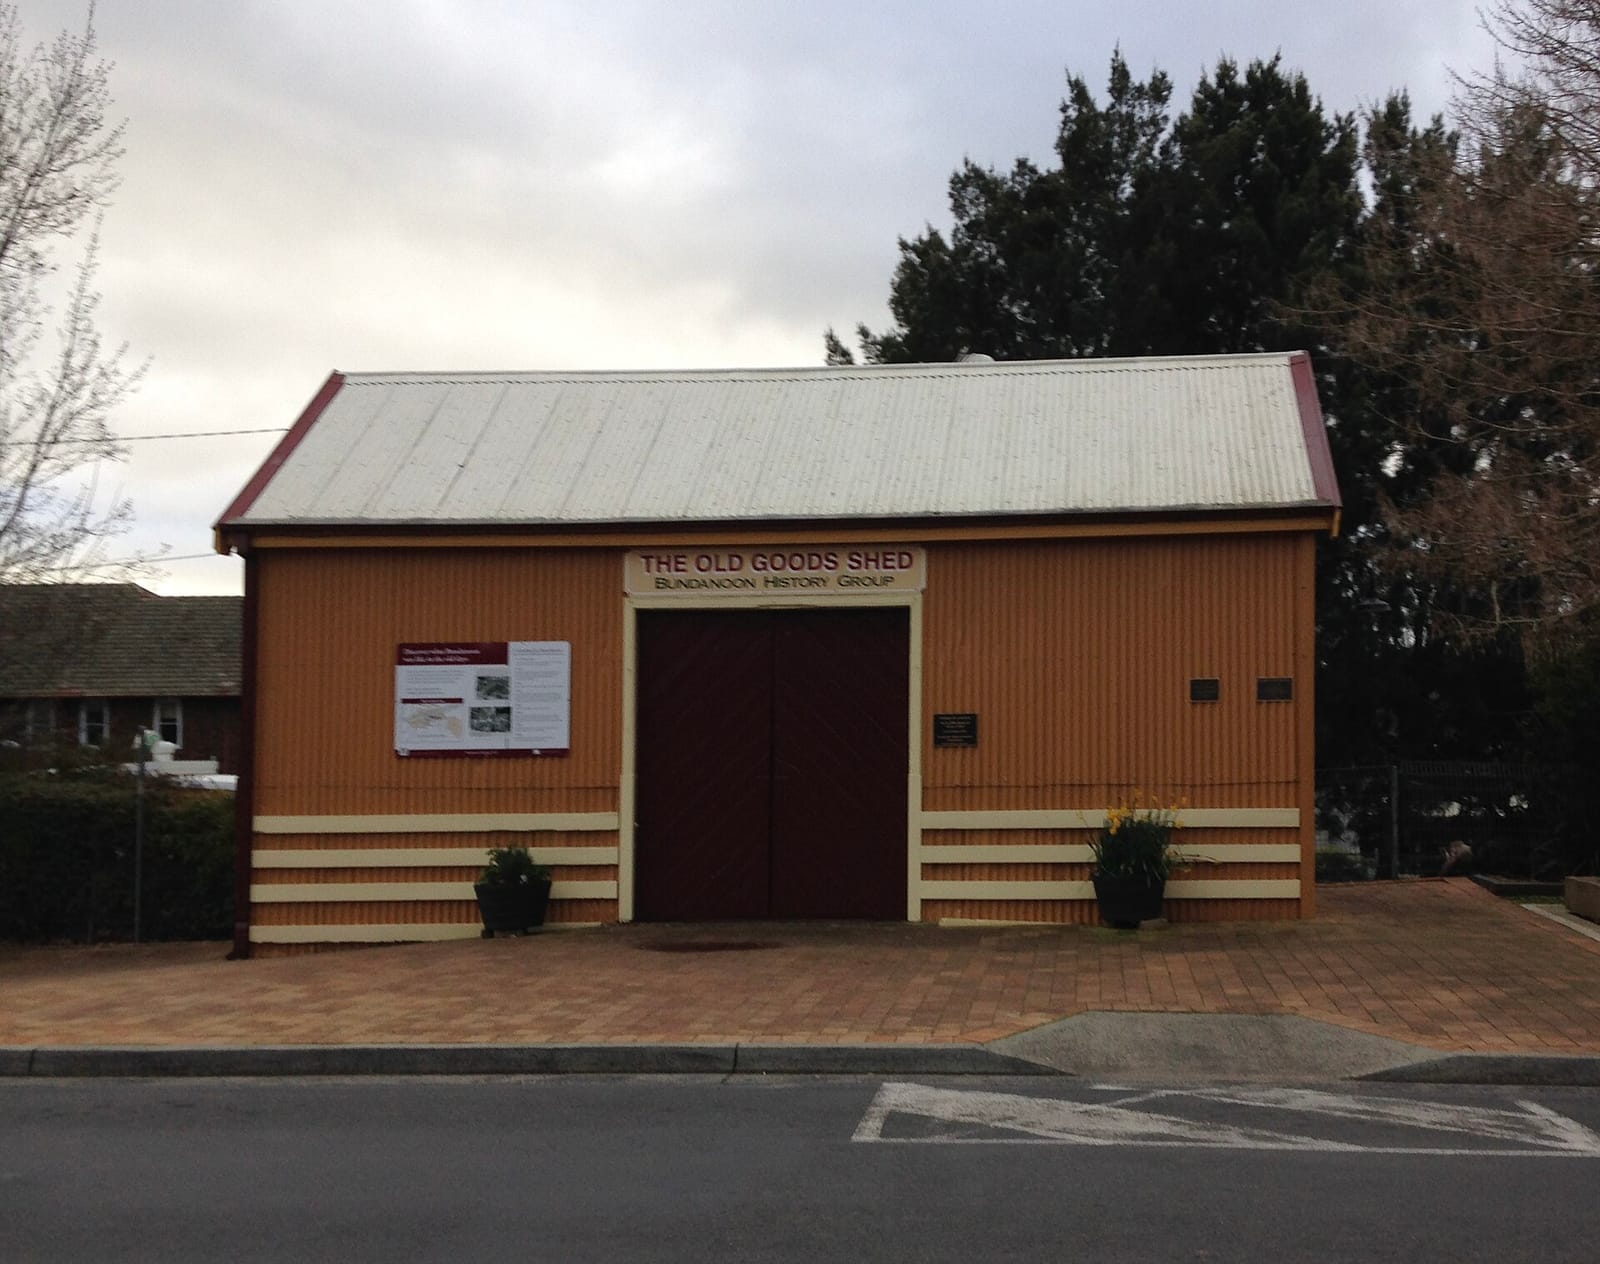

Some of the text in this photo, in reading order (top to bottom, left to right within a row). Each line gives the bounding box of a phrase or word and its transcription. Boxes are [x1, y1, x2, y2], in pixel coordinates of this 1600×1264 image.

[640, 551, 914, 574] THE OLD GOODS SHED
[654, 574, 896, 590] BUNDANOON HISTORY GROUP
